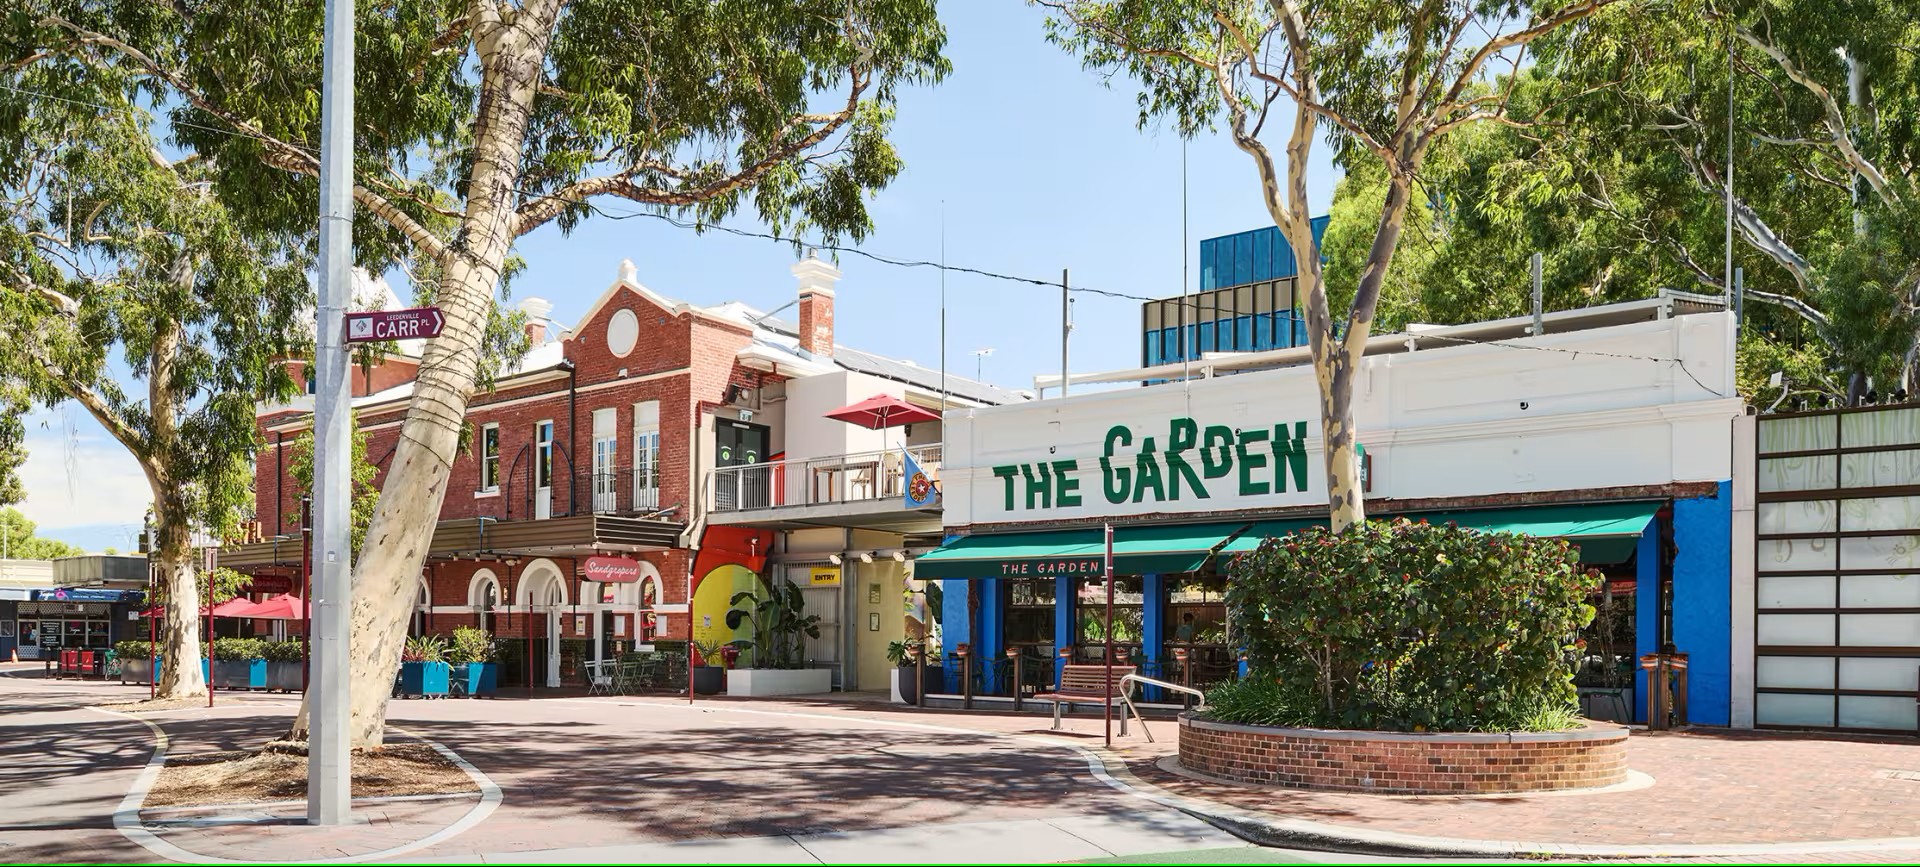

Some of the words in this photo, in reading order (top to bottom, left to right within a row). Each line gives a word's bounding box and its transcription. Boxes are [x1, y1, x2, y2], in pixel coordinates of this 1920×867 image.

[387, 313, 419, 321] LEEDERVILLE
[376, 320, 419, 338] CARR
[992, 459, 1082, 511] THE
[1100, 417, 1308, 504] GARDEN
[587, 561, 637, 578] Sandgropers
[1002, 562, 1029, 574] THE
[1037, 561, 1099, 573] GARDEN
[814, 573, 836, 581] ENTRY
